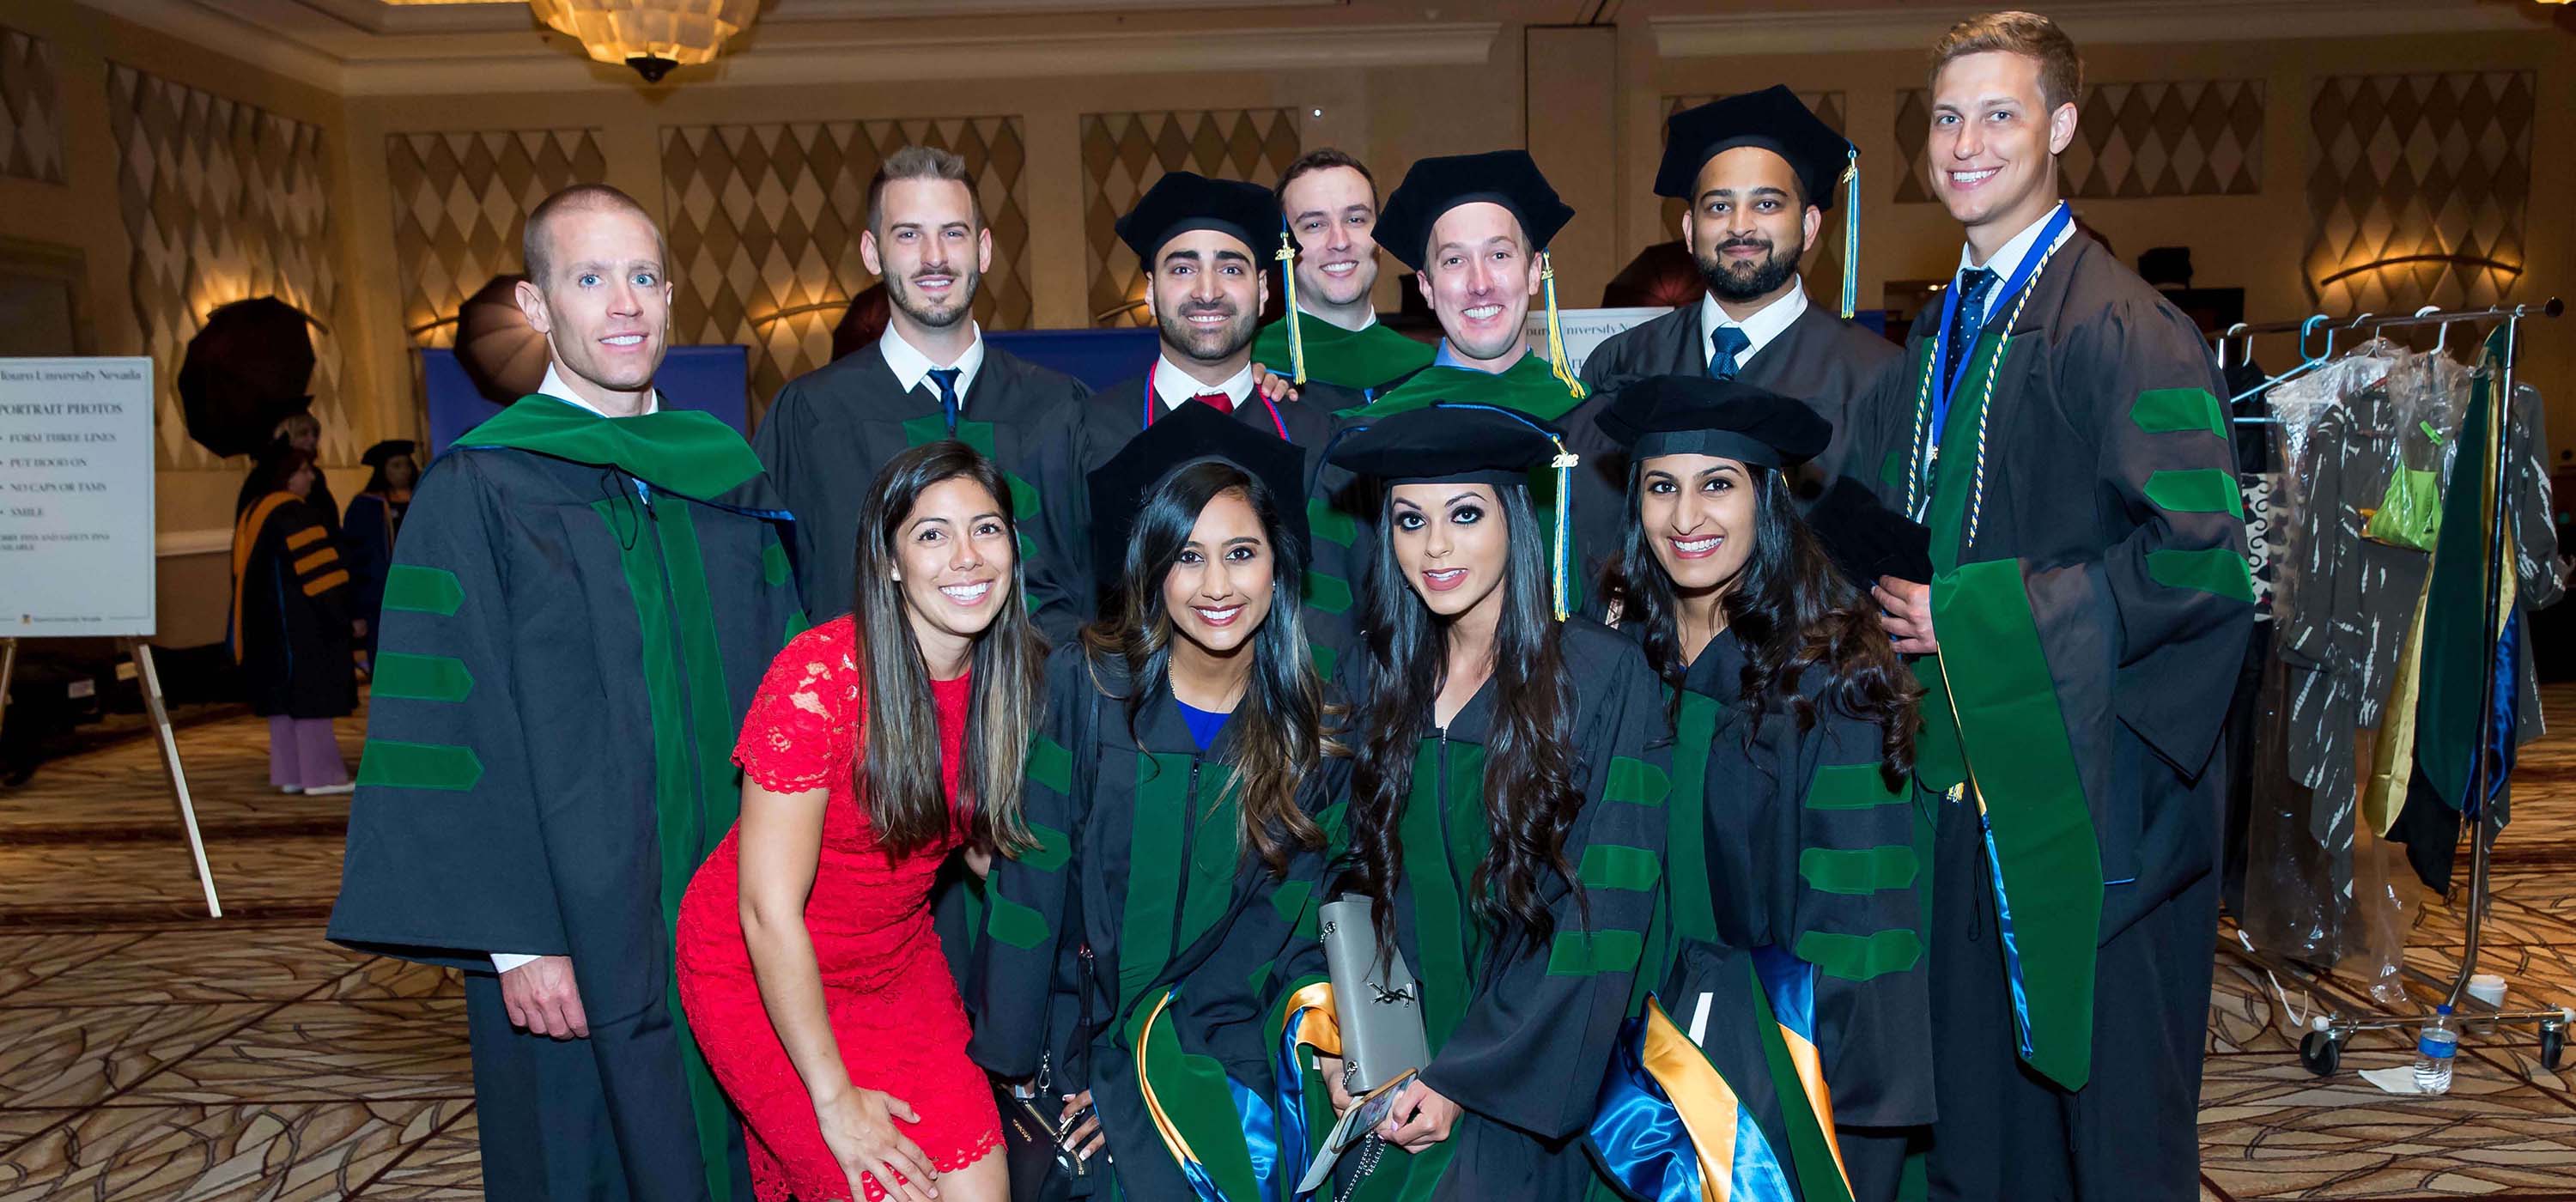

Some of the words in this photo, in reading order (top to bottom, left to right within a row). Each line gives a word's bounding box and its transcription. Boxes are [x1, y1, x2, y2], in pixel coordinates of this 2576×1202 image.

[1565, 323, 1615, 335] niversity
[36, 370, 95, 381] University
[99, 368, 142, 380] Nevada
[67, 403, 124, 414] PHOTOS
[10, 432, 42, 442] FORM
[46, 432, 80, 442] THREE
[83, 432, 117, 442] LINES
[10, 458, 31, 467] PUT
[33, 458, 68, 467] HOOD
[70, 458, 88, 467] ON
[10, 483, 27, 492] NO
[29, 483, 57, 492] CAPS
[59, 483, 75, 492] OR
[10, 507, 44, 517] SMILE
